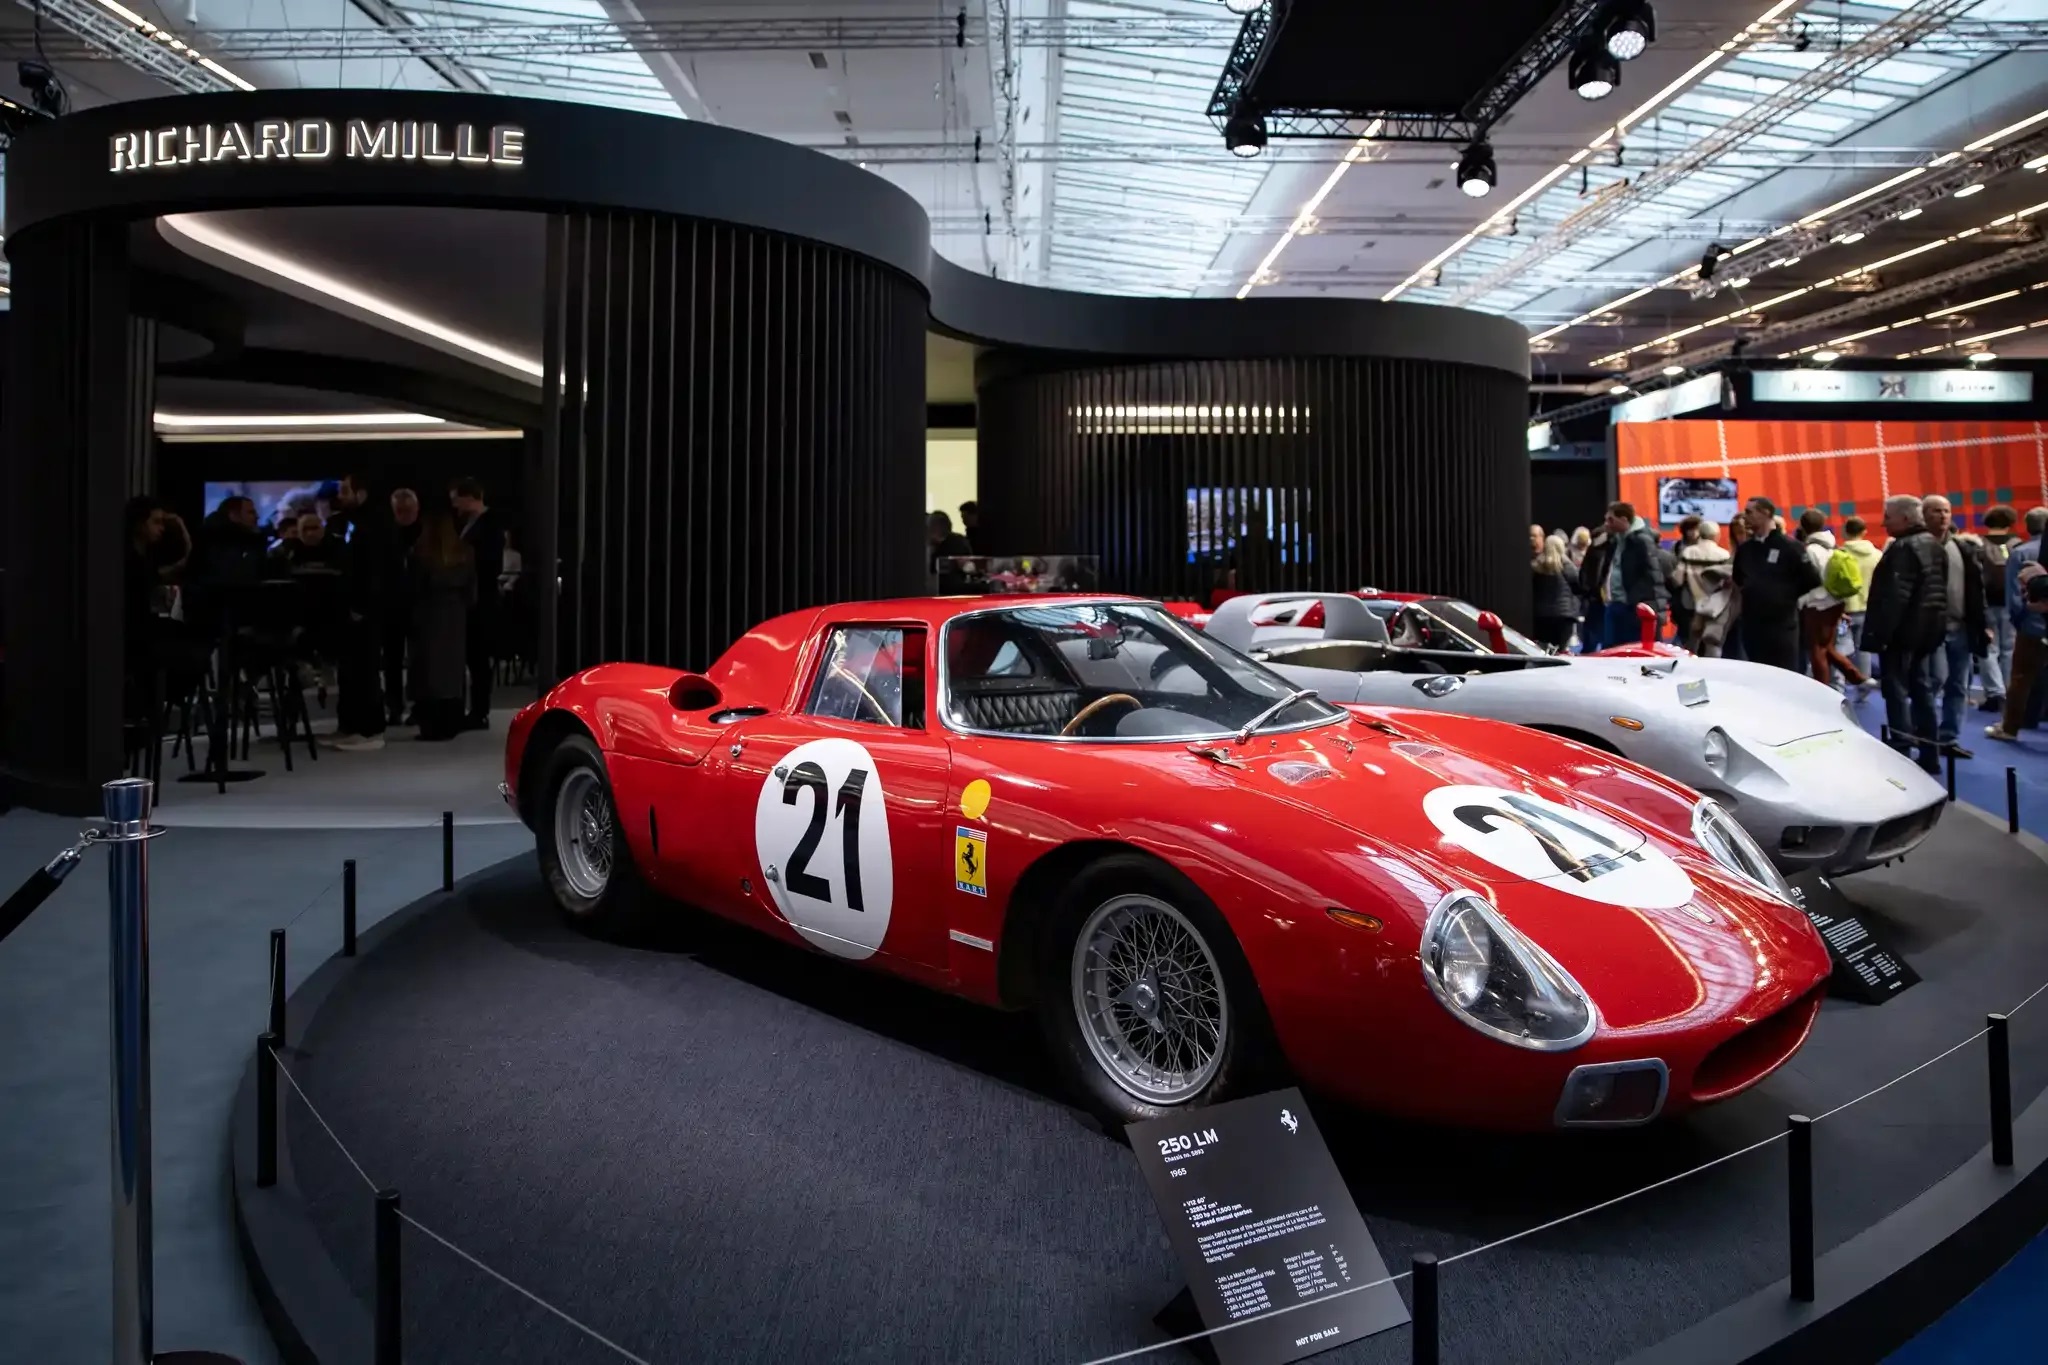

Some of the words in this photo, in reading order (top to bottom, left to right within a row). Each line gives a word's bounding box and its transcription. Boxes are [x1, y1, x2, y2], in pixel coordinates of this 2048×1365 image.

[109, 118, 331, 172] RICHARD
[346, 119, 524, 165] MILLE
[782, 761, 868, 912] 21
[1453, 795, 1646, 883] 21
[1157, 1135, 1191, 1155] 250
[1193, 1128, 1219, 1146] LM
[1169, 1167, 1187, 1178] 1965
[1295, 1336, 1309, 1347] NOT
[1309, 1332, 1323, 1342] FOR
[1322, 1326, 1340, 1337] SALE
